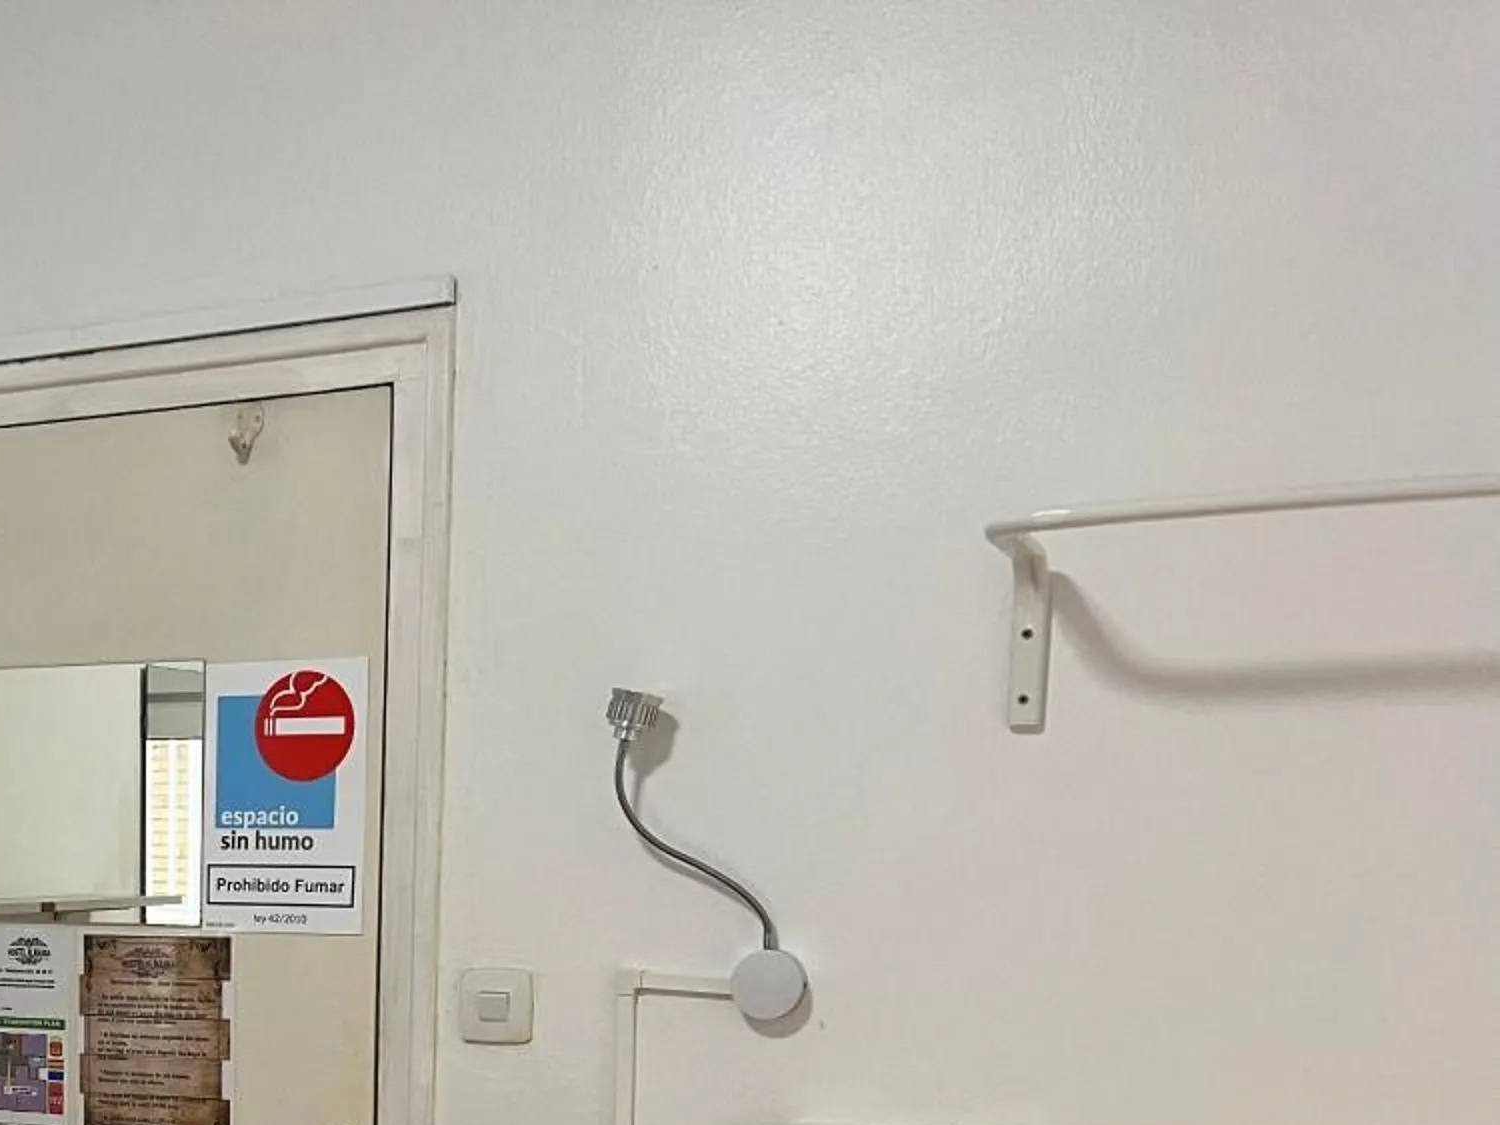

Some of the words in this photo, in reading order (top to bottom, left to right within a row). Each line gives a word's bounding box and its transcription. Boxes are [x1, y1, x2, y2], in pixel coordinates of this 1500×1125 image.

[221, 805, 299, 829] espacio
[220, 830, 249, 850] sin
[255, 830, 314, 850] humo
[216, 877, 290, 893] Prohibido
[295, 879, 345, 893] Fumar
